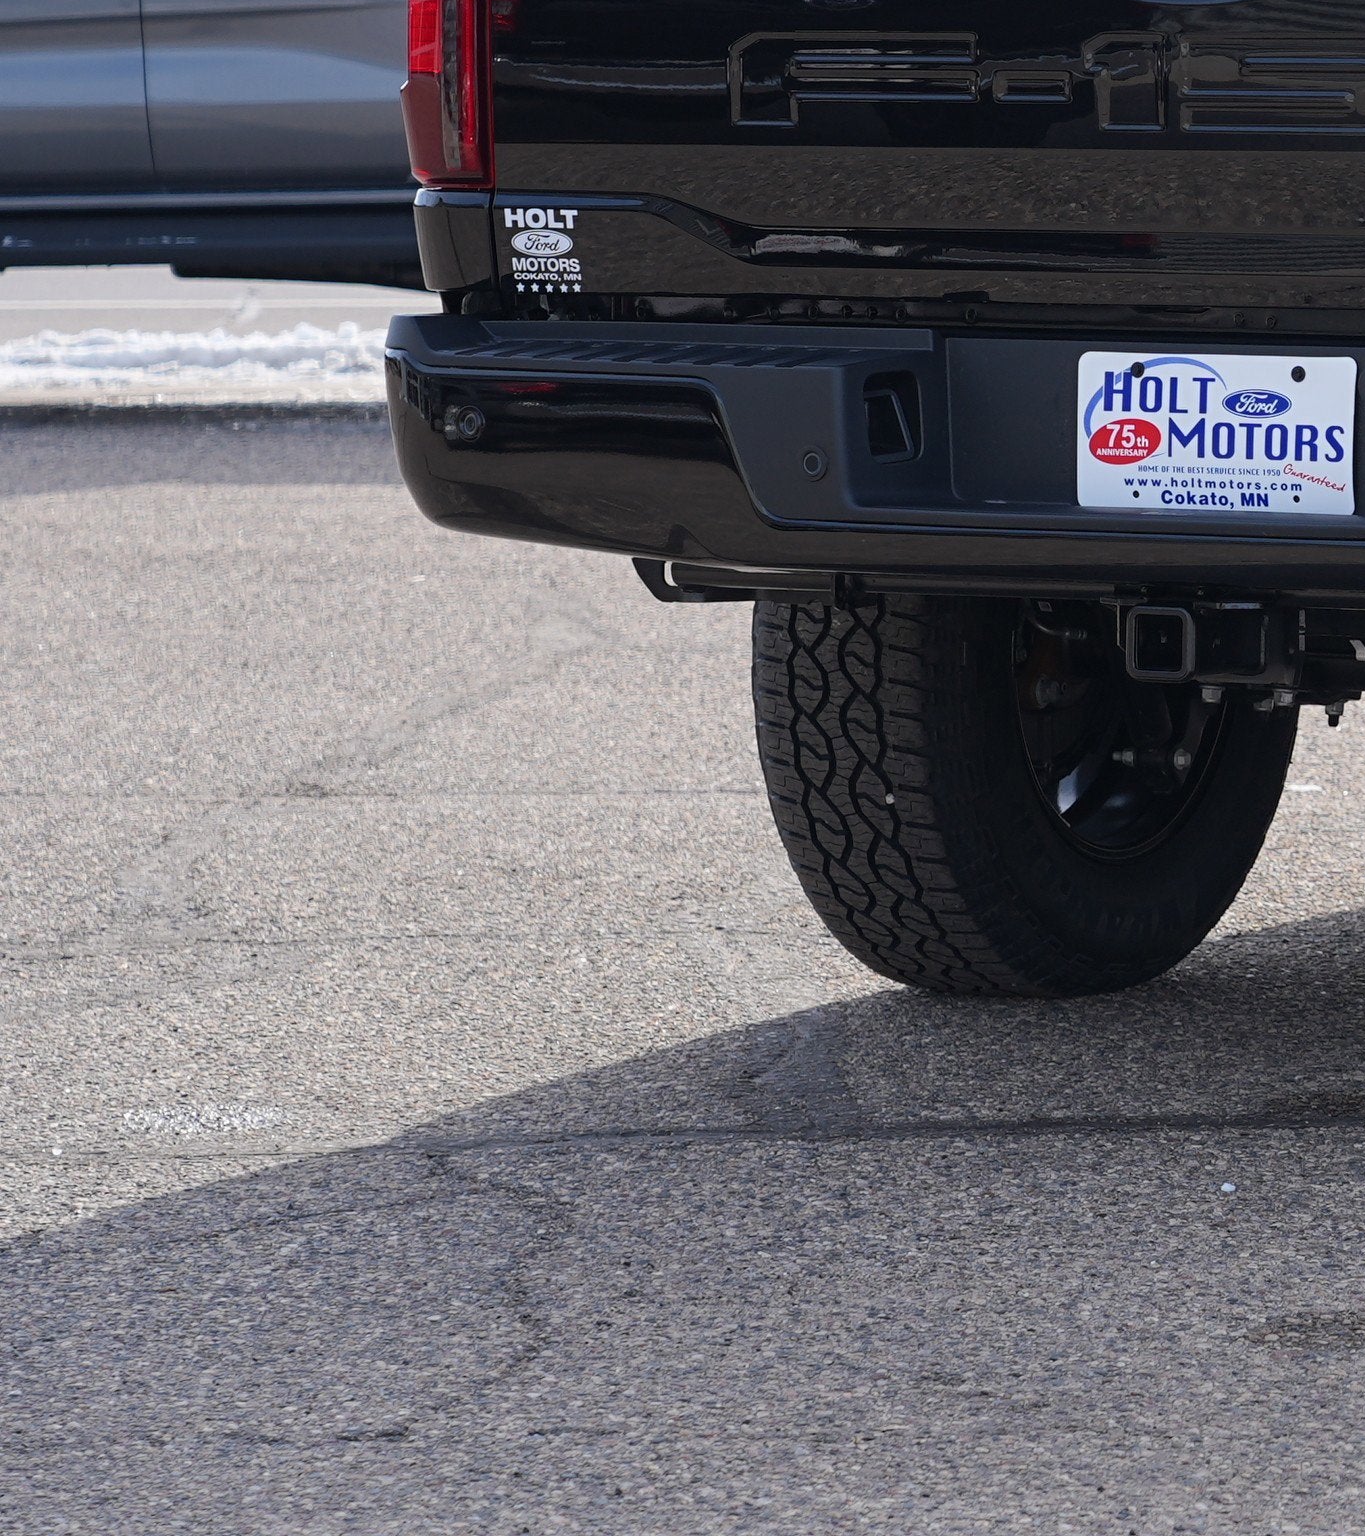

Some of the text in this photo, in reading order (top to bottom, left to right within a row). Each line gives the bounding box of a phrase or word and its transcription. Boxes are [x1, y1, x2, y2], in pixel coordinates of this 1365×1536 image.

[503, 208, 578, 229] HOLT
[524, 233, 560, 252] Ford
[511, 257, 580, 273] MOTORS
[513, 272, 582, 282] COKATO, MN
[1102, 370, 1278, 414] HOLT Ford
[1106, 423, 1149, 448] 75th
[1167, 417, 1346, 463] MOTORS
[1096, 447, 1148, 457] ANNIVERSARY
[1124, 477, 1303, 492] www.holtmotors.com
[1138, 465, 1158, 473] HOME
[1172, 466, 1185, 474] THE
[1188, 466, 1204, 474] BEST
[1239, 468, 1260, 476] SINCE
[1262, 468, 1281, 476] 1950
[1283, 463, 1345, 493] Guaranteed
[1160, 490, 1269, 509] Cokato, MN
